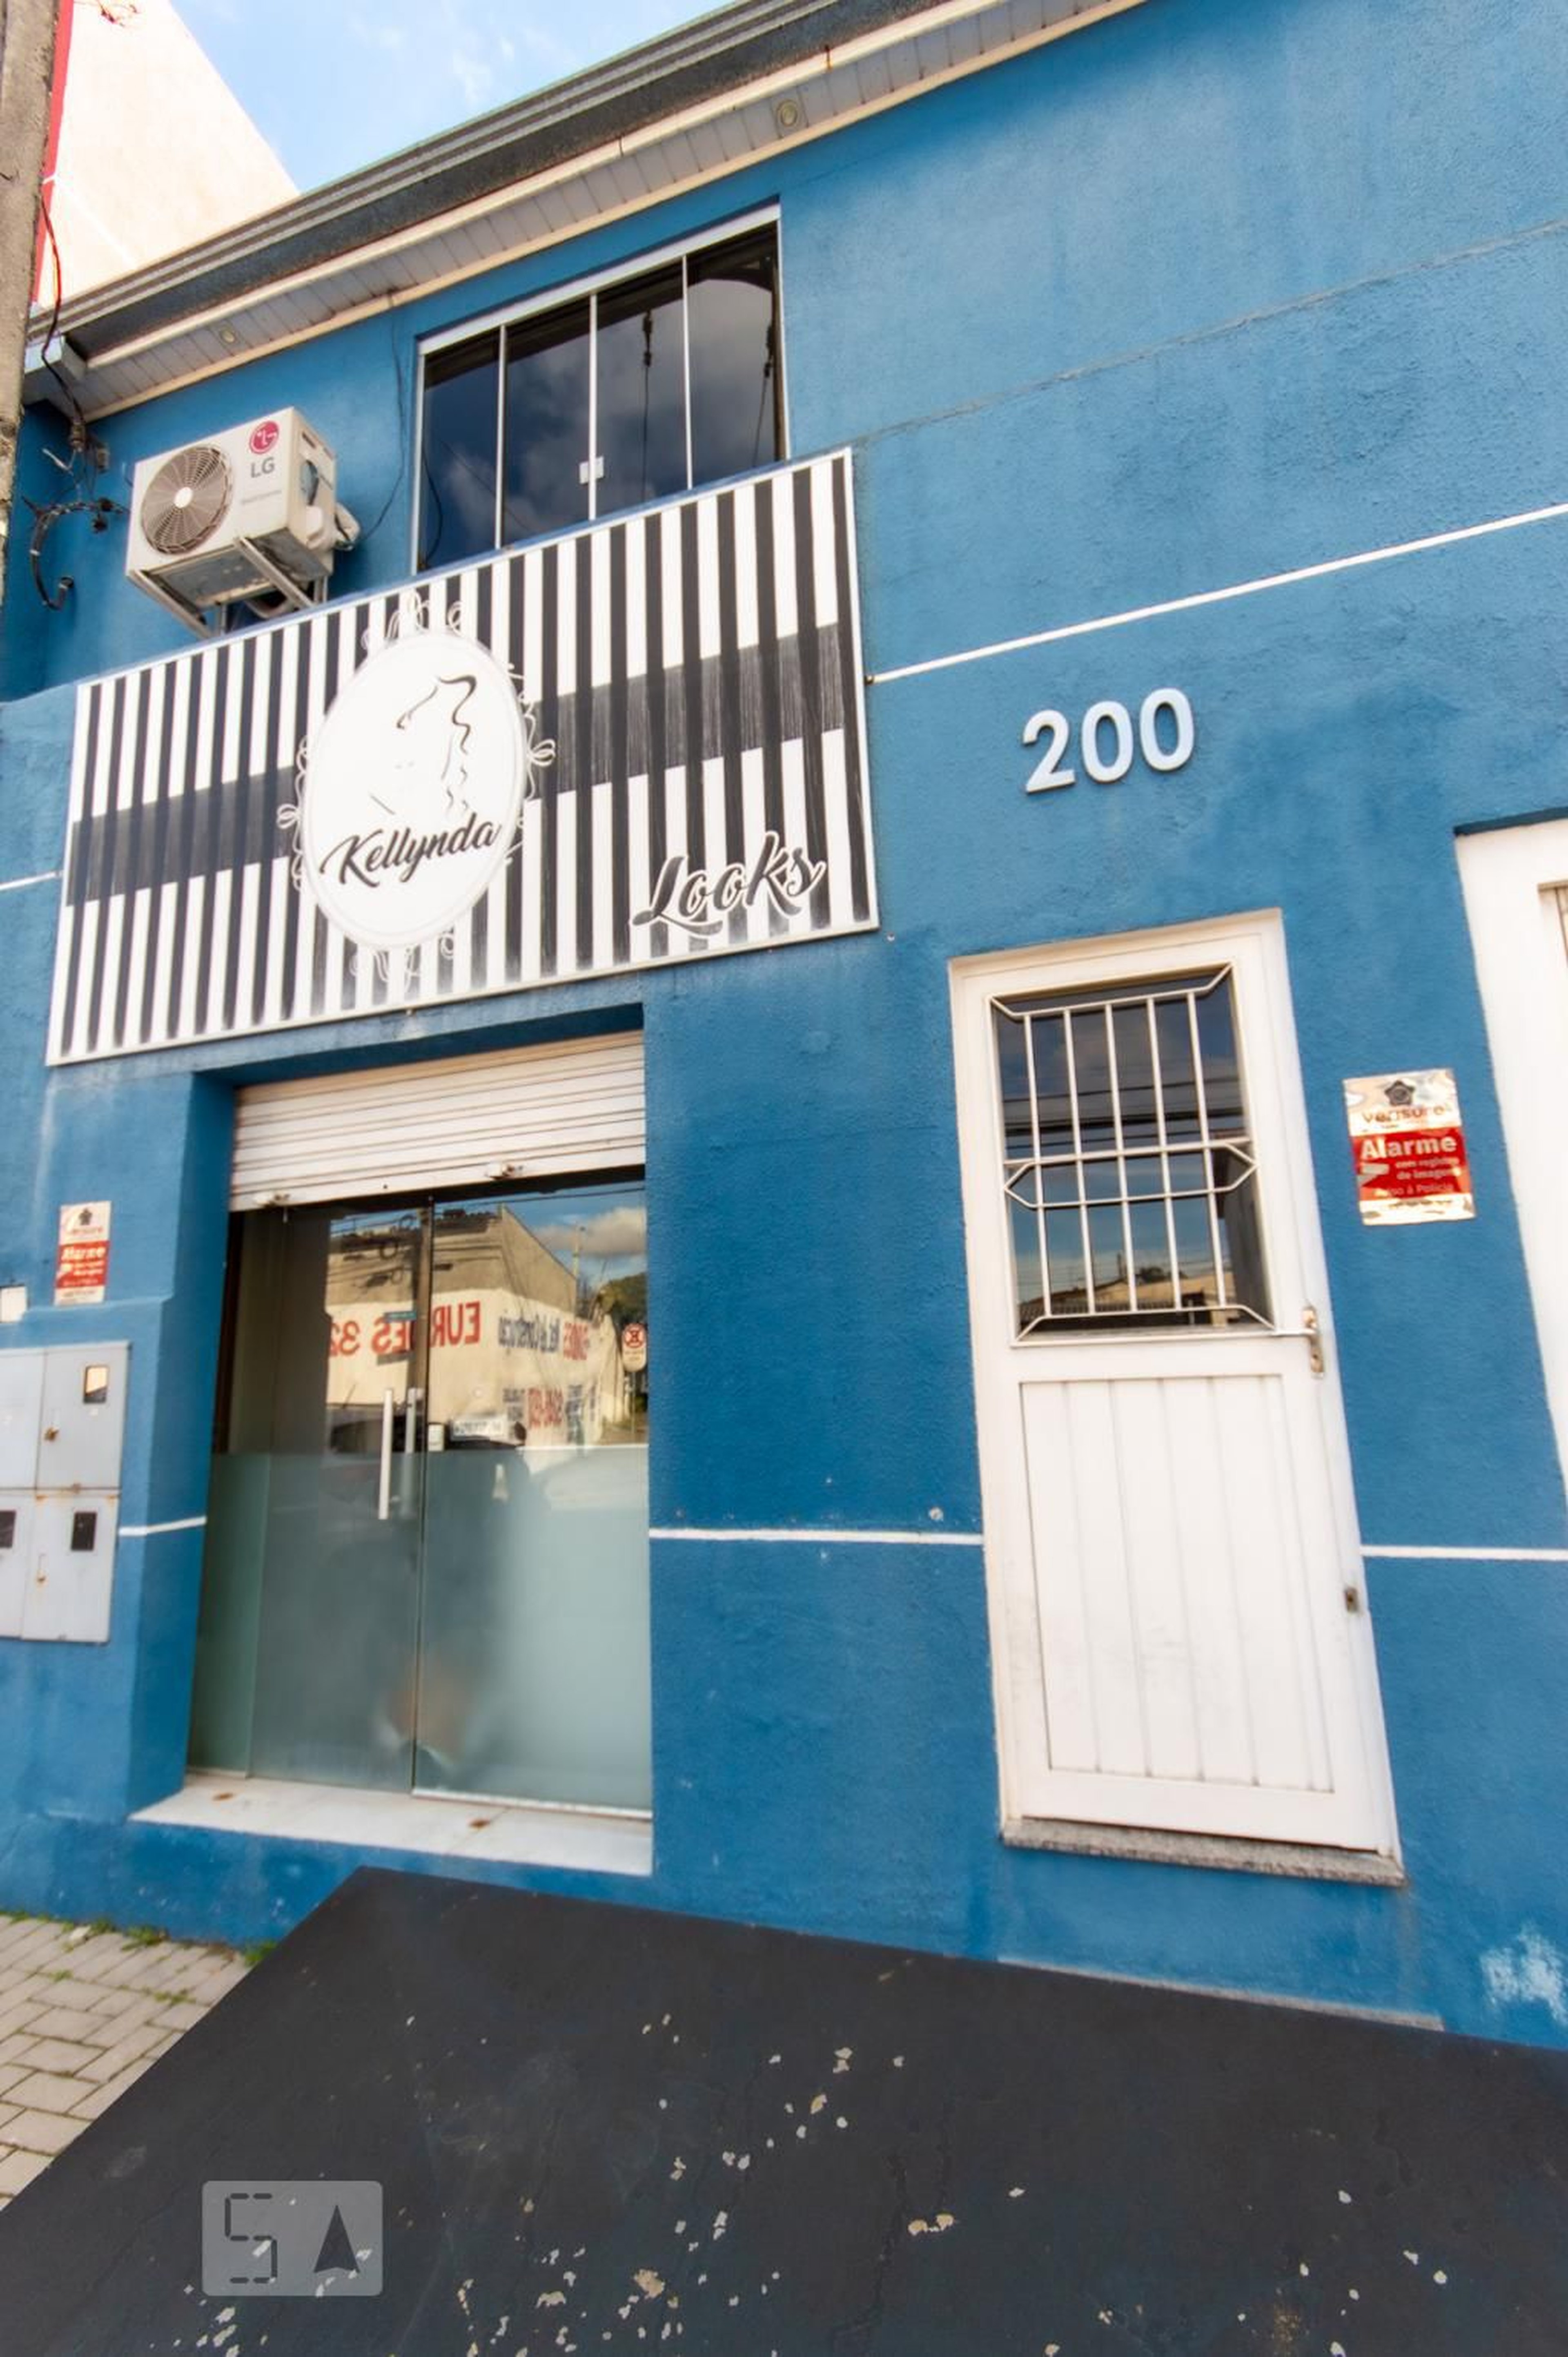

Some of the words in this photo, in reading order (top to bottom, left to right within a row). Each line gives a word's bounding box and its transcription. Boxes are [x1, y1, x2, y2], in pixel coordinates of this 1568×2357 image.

[250, 457, 276, 478] LG
[1023, 688, 1194, 793] 200
[319, 812, 502, 888] Kellynda
[630, 830, 829, 938] Looks
[1360, 1136, 1457, 1159] Alarme
